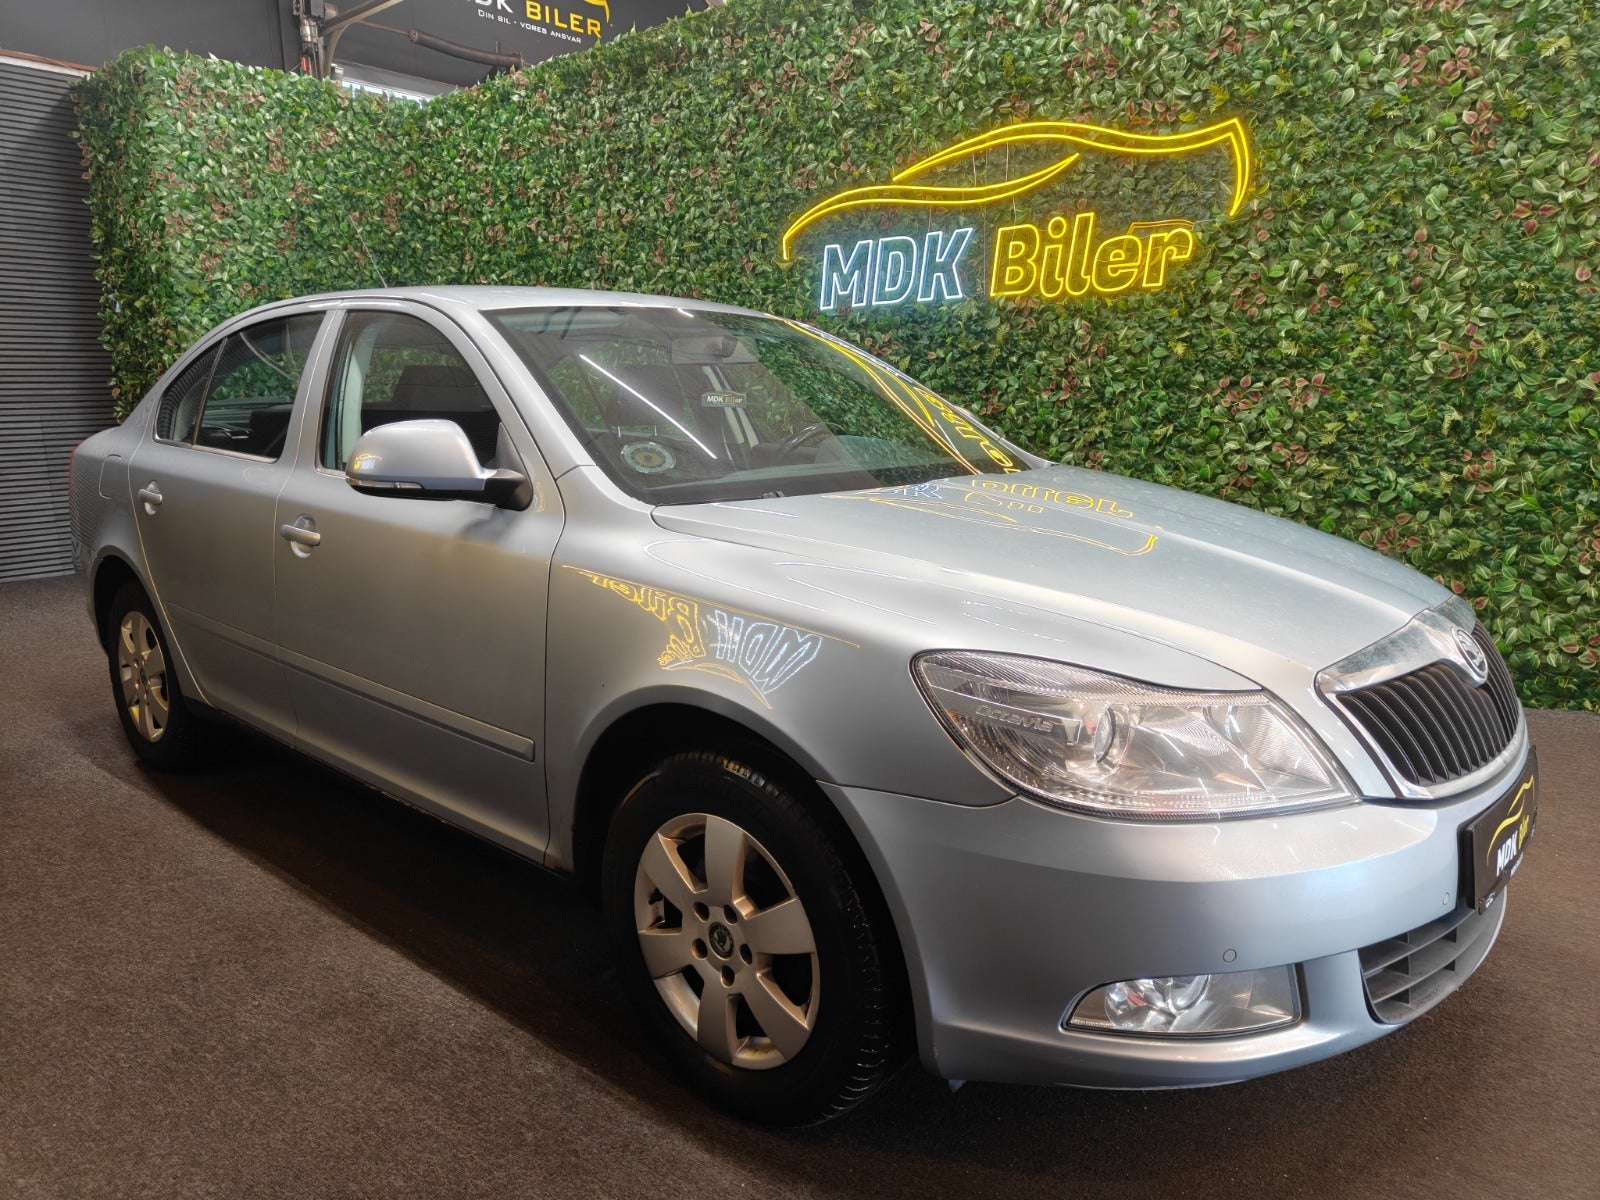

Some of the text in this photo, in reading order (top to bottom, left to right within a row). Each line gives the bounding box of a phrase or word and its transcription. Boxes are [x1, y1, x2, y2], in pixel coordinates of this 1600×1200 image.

[477, 9, 494, 20] DIN
[497, 15, 511, 24] BIL
[520, 22, 547, 34] VORES
[550, 30, 582, 43] ANSVAR
[526, 0, 602, 38] BILER
[820, 211, 1197, 311] MDK Biler
